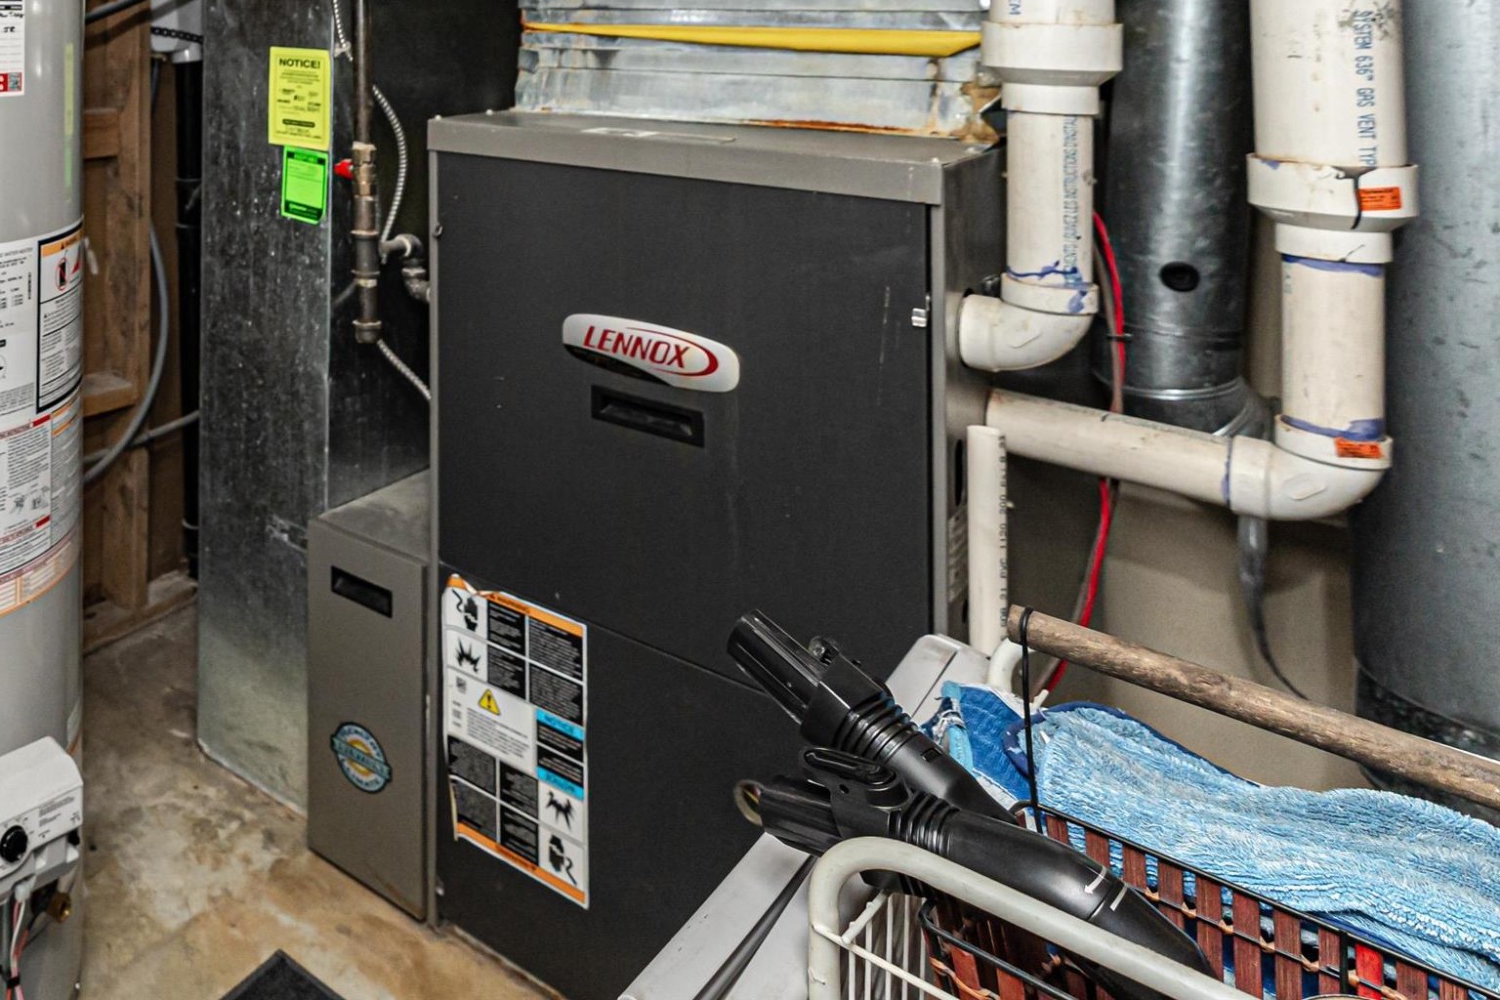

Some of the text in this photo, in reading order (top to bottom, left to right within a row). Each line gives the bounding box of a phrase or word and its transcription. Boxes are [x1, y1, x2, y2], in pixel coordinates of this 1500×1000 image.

[1353, 10, 1373, 50] SYSTEM
[279, 58, 320, 69] NOTICE!
[1357, 87, 1375, 108] GAS
[1358, 113, 1376, 140] VENT
[583, 325, 690, 369] LENNOX
